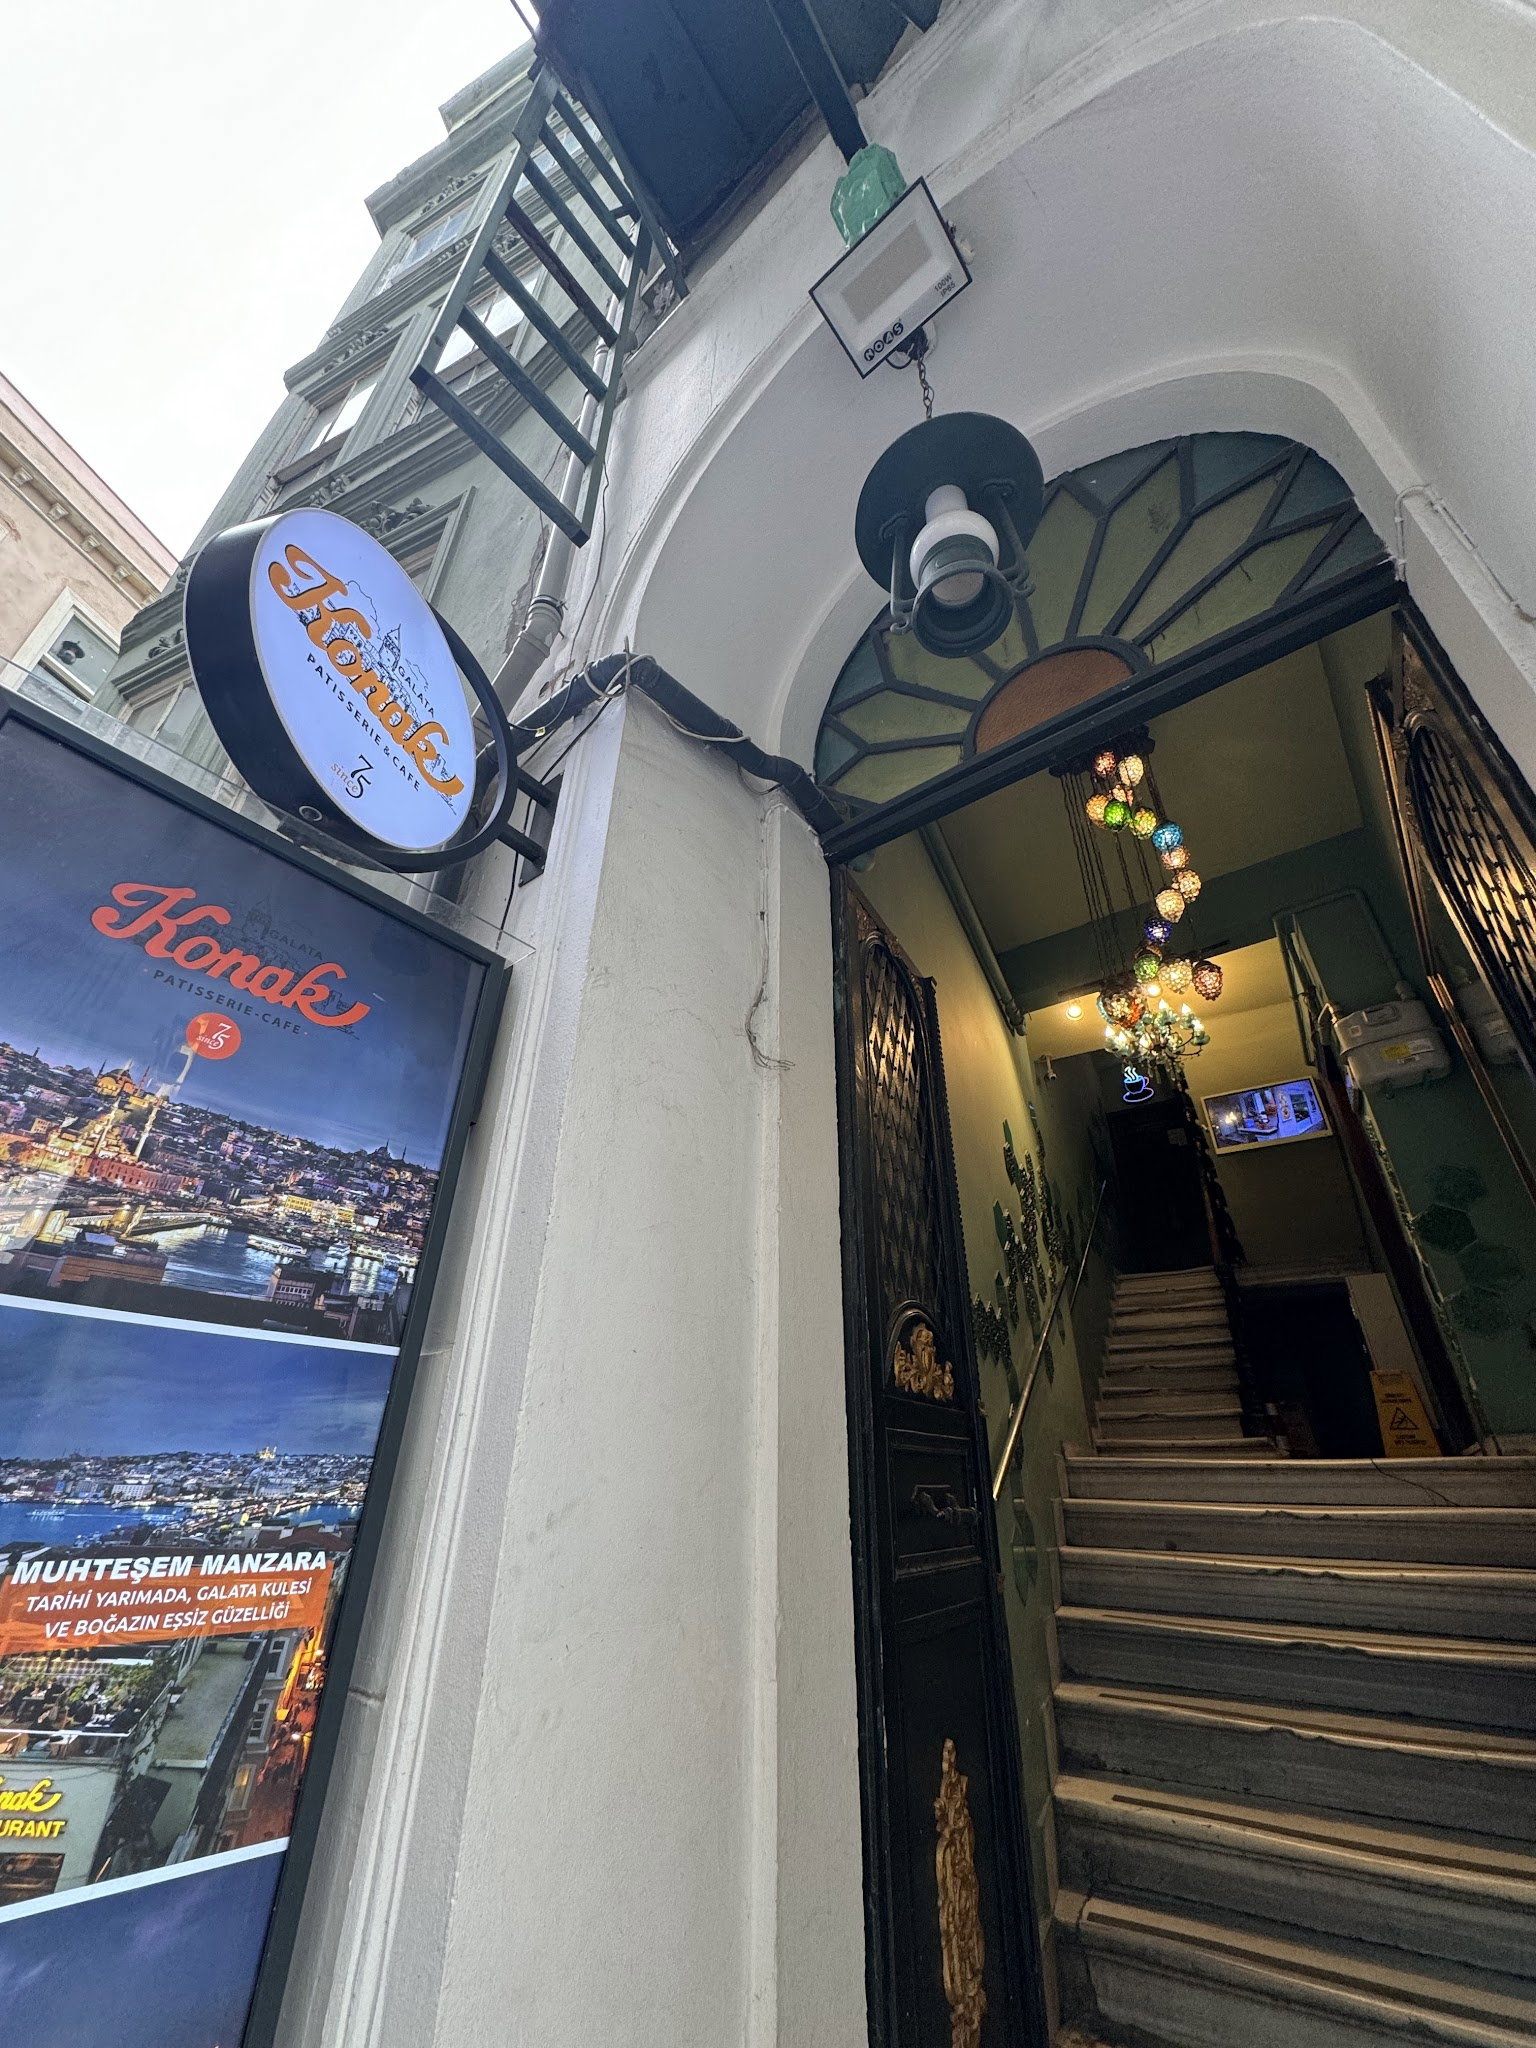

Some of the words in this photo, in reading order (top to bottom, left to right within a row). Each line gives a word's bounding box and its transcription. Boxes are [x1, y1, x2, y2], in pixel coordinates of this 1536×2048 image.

[934, 273, 952, 292] 100W
[864, 322, 904, 361] NOAS
[268, 543, 465, 796] Konak
[398, 664, 436, 719] GALATA
[306, 652, 381, 746] PATISSERIE
[383, 745, 392, 757] &
[392, 756, 420, 792] CAFE
[331, 762, 359, 793] since
[91, 882, 371, 1027] Konak
[268, 929, 323, 961] GALATA
[196, 1034, 220, 1047] since
[10, 1555, 194, 1585] MUHTEŞEM
[199, 1551, 327, 1576] MANZARA
[26, 1589, 93, 1612] TARİHİ
[96, 1586, 191, 1607] YARIMADA,
[197, 1583, 257, 1601] GALATA
[261, 1577, 312, 1597] KULESİ
[44, 1621, 70, 1639] VE
[74, 1614, 160, 1637] BOĞAZIN
[163, 1608, 208, 1632] EŞSİZ
[211, 1601, 291, 1624] GÜZELLİĞİ
